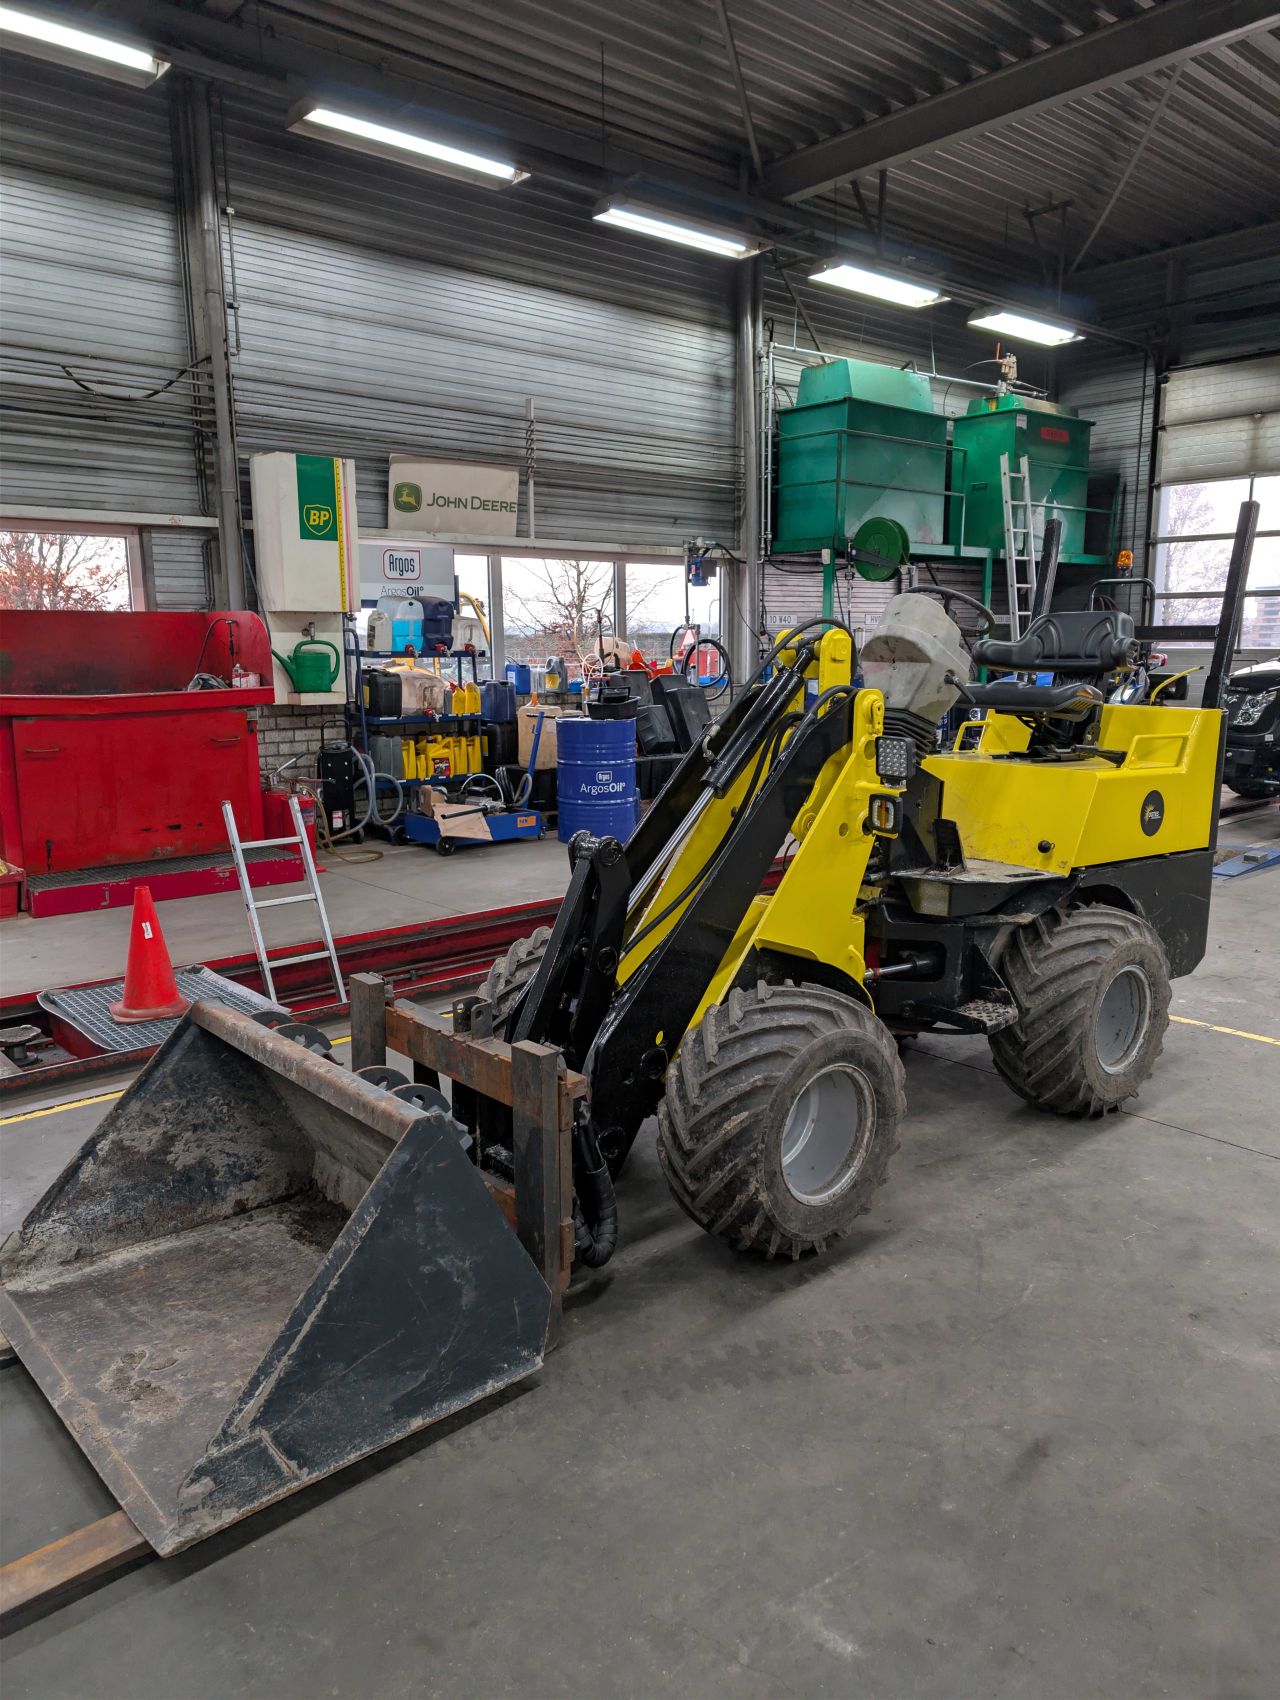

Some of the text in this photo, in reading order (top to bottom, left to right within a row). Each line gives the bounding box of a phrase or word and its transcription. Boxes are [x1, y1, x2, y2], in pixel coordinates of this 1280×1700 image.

[427, 493, 517, 513] JOHN DEERE
[309, 510, 329, 526] BP
[389, 553, 415, 576] Argos
[779, 615, 792, 624] W40
